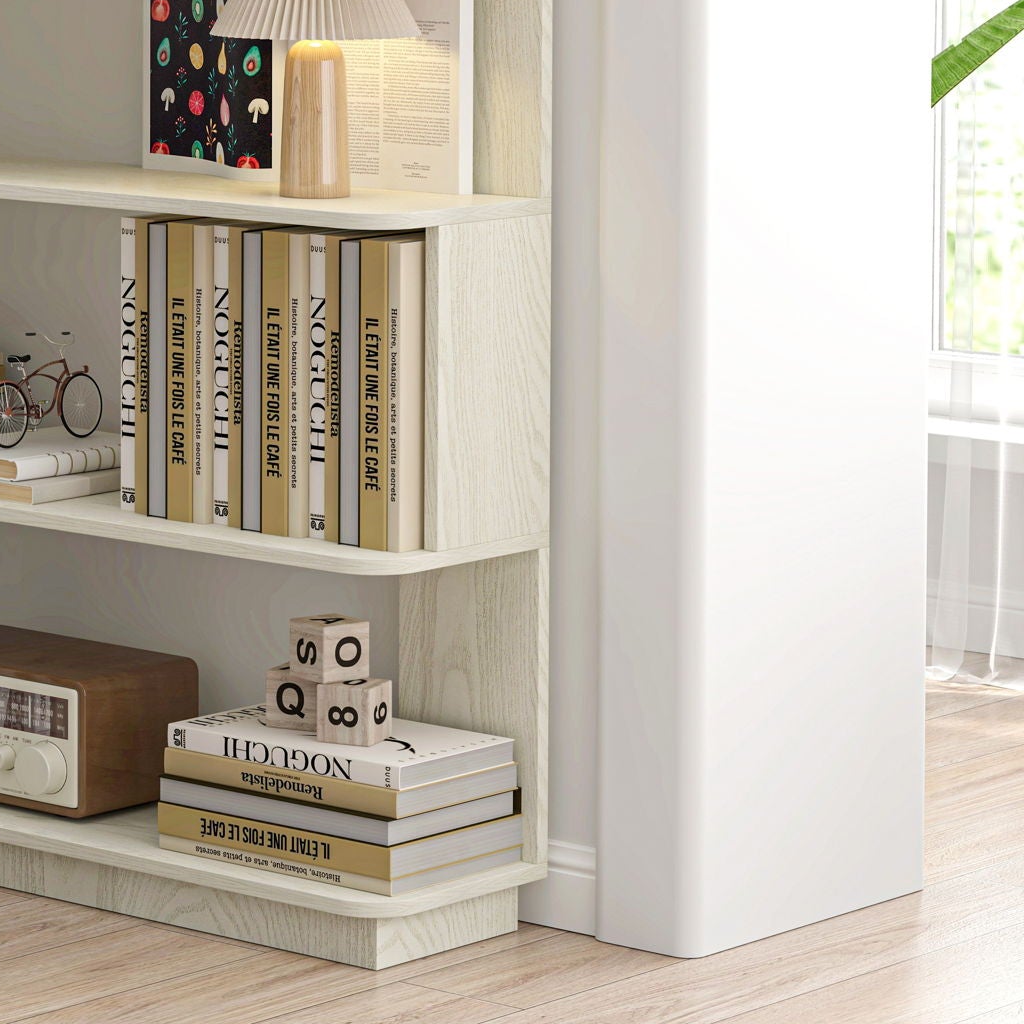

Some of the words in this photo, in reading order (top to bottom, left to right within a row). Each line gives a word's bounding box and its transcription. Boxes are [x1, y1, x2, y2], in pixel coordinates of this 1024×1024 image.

[365, 317, 379, 330] IL
[122, 275, 136, 438] NOGUCHI
[214, 285, 229, 450] NOGUCHI
[365, 333, 382, 371] ÉTAIT
[310, 294, 326, 463] NOGUCHI
[365, 374, 379, 401] UNE
[390, 351, 398, 400] botanique,
[365, 404, 379, 434] FOIS
[391, 426, 397, 435] et
[365, 437, 379, 454] LE
[365, 457, 381, 492] CAFÉ
[296, 638, 317, 665] S
[276, 682, 305, 719] Q
[328, 705, 358, 728] 8
[222, 735, 352, 780] NOGUCHI
[241, 771, 324, 801] Remodelista
